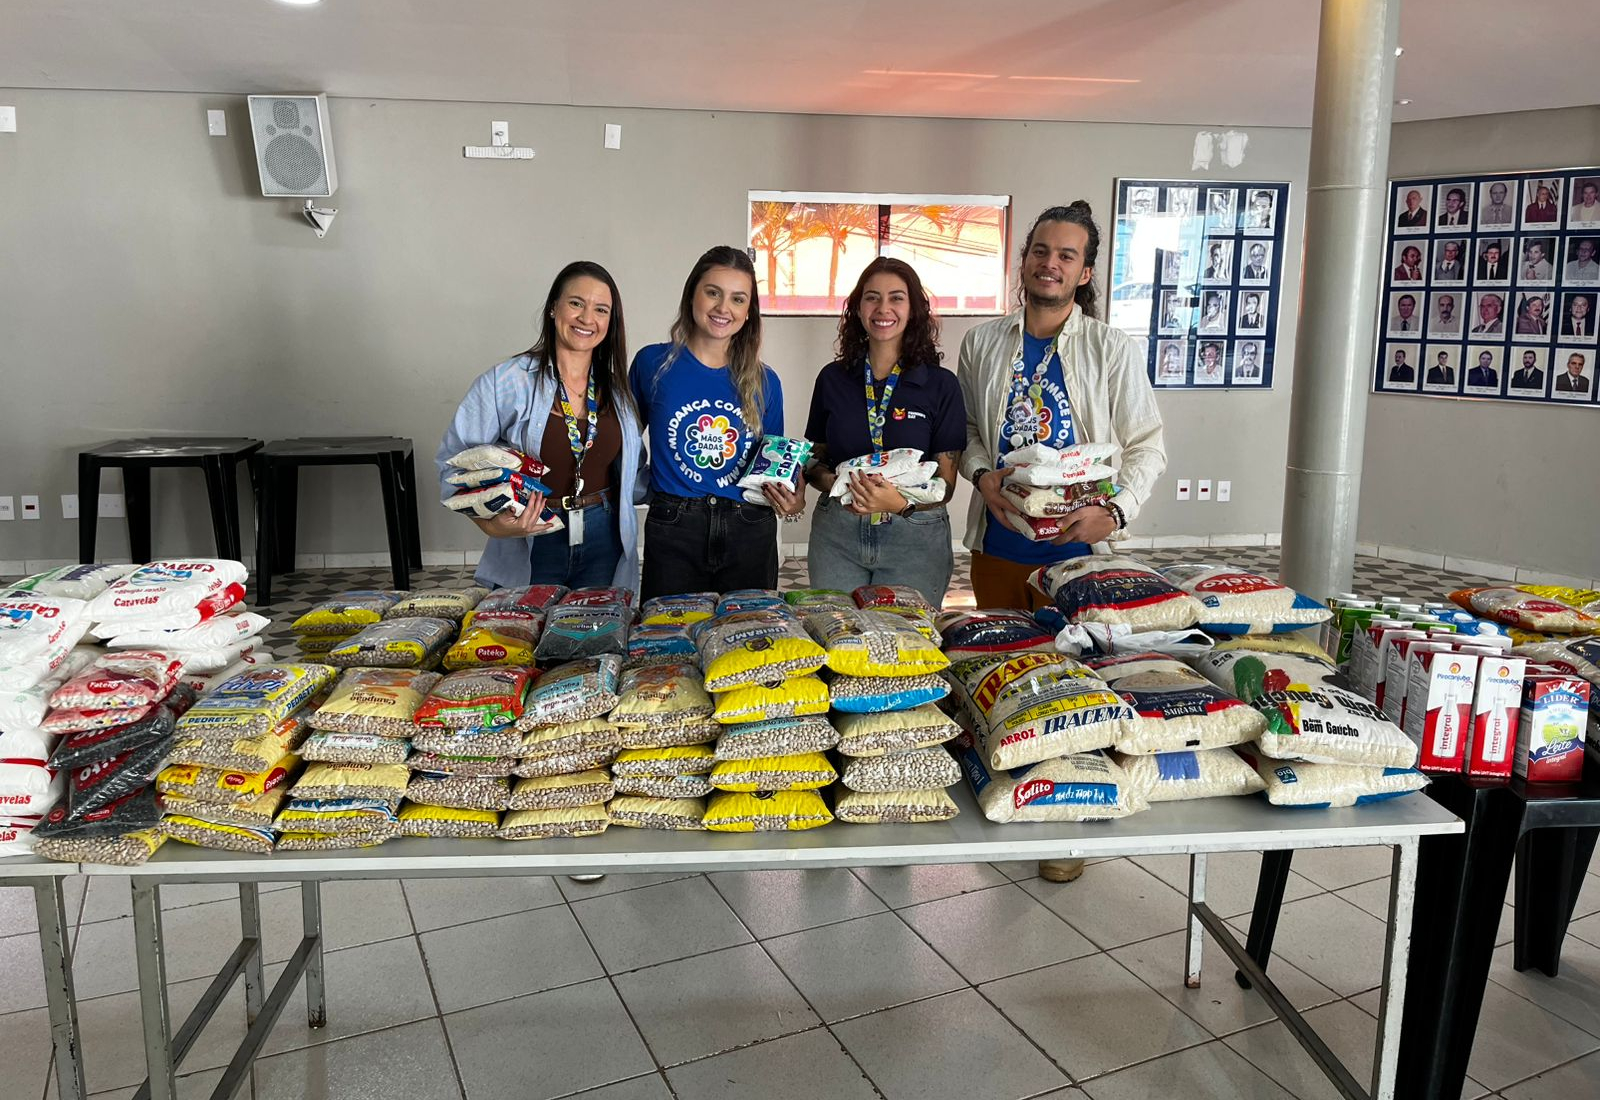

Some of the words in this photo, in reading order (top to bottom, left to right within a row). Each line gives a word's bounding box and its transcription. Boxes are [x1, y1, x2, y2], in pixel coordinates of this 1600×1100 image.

[1040, 378, 1070, 416] OMECE
[668, 399, 710, 449] MUDANÇA
[700, 434, 723, 443] MÃOS
[1054, 420, 1070, 448] POR
[674, 452, 682, 461] A
[698, 443, 724, 451] DADAS
[737, 442, 752, 467] POR
[680, 462, 702, 482] QUE
[716, 466, 740, 488] MIM
[114, 596, 160, 607] Caravelas
[724, 627, 787, 644] UBIRAMA
[976, 653, 1066, 713] IRACEM
[1437, 673, 1471, 683] Piracanjuba
[286, 684, 318, 710] PEDRETTI
[350, 695, 396, 706] Campeão
[188, 716, 238, 724] PEDRETTI
[1043, 706, 1134, 736] IRACEMA
[1302, 719, 1323, 733] Bem
[1326, 721, 1359, 738] Gaúcho
[1000, 728, 1036, 747] ARROZ
[1440, 714, 1452, 750] integral
[1490, 718, 1502, 754] integral
[1542, 739, 1572, 755] Leite
